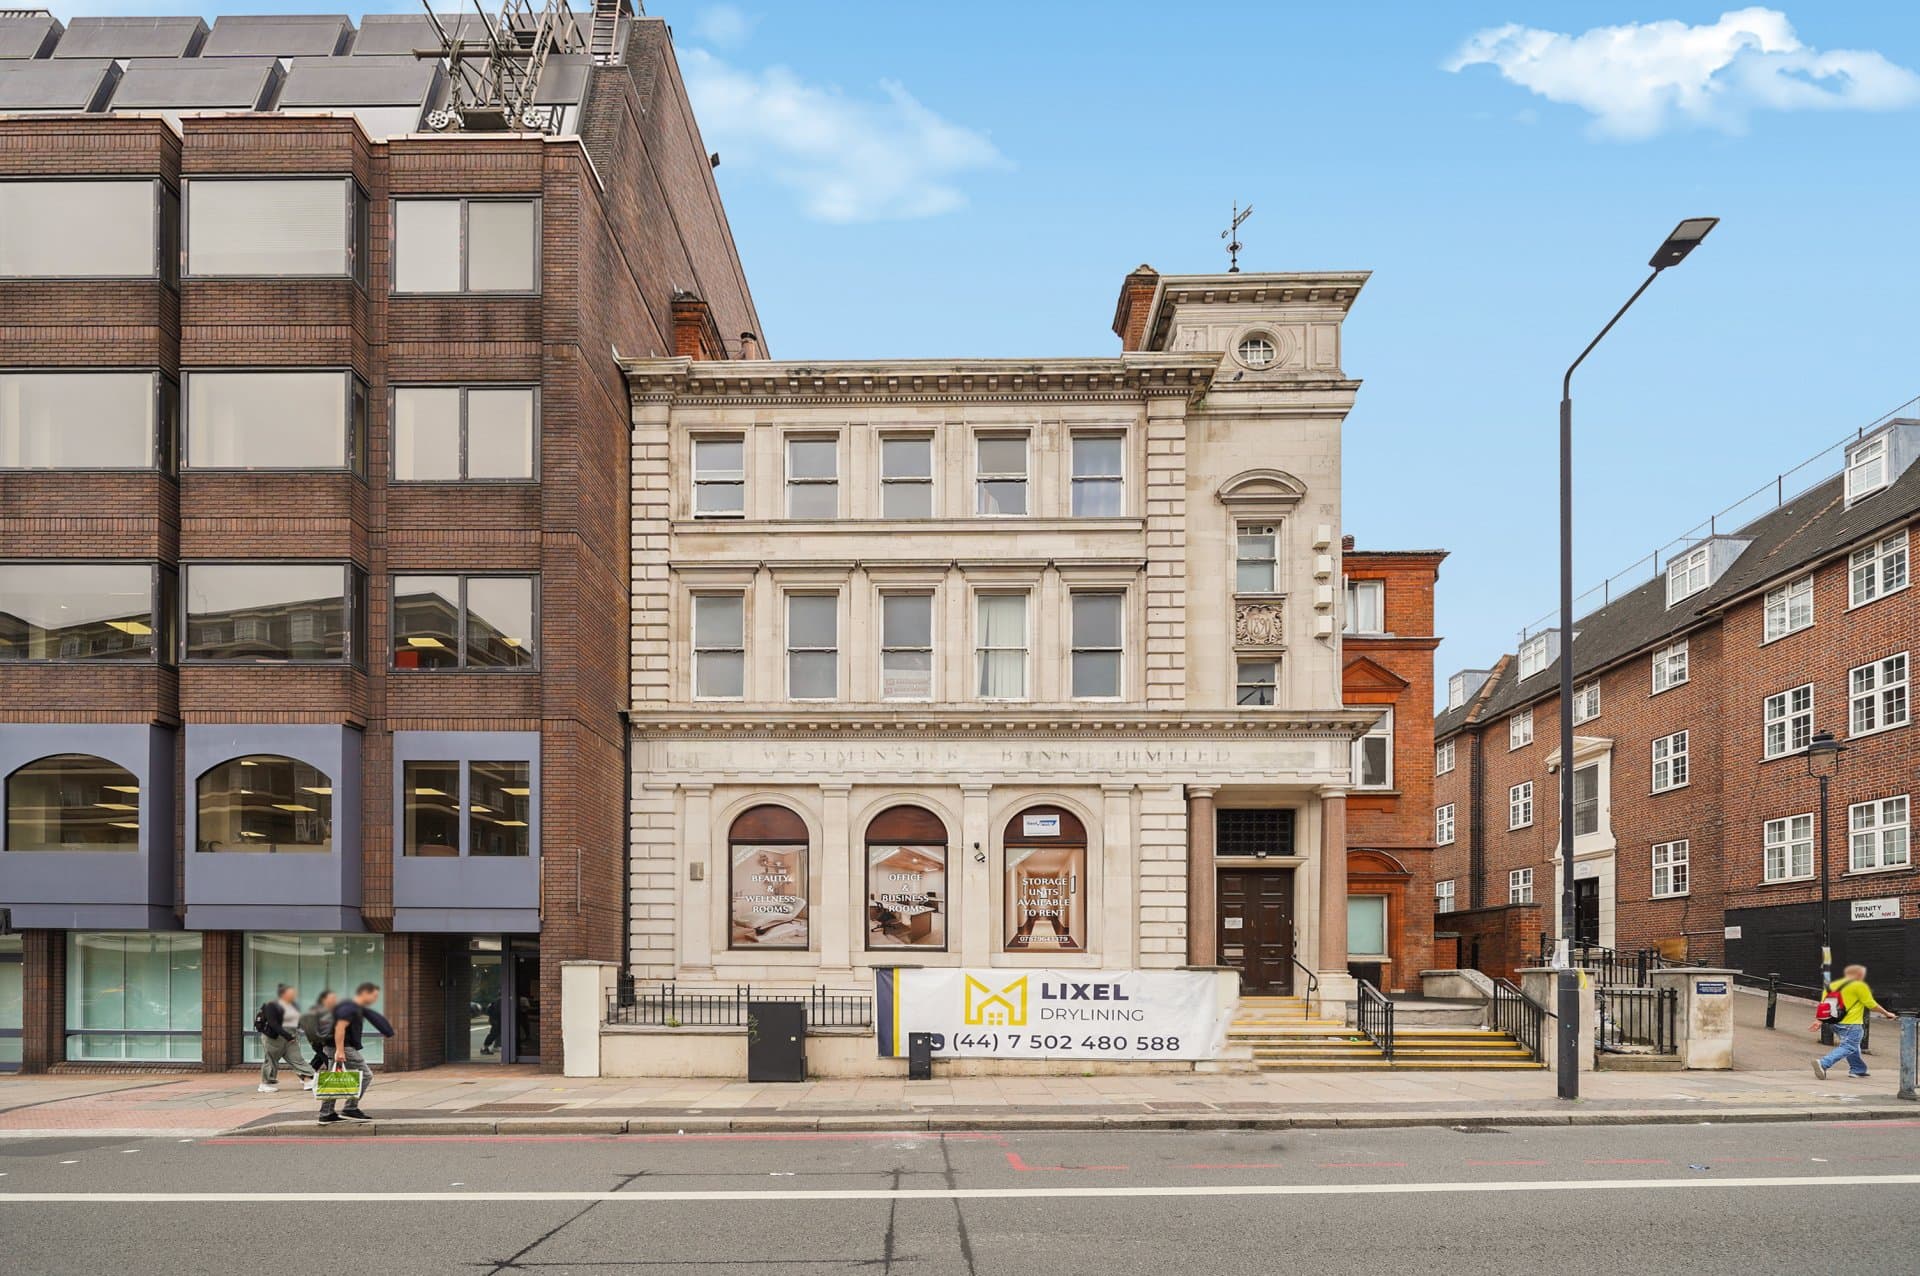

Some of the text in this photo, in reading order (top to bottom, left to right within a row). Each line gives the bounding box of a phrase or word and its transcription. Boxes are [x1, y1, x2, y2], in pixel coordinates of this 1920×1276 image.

[763, 750, 1232, 762] WESTMINSTER BANK LIMITED
[751, 874, 789, 882] BEAUTY
[889, 873, 923, 881] OFFICE
[1022, 877, 1068, 886] STORAGE
[767, 885, 774, 893] &
[1029, 888, 1059, 896] UNITS
[745, 895, 796, 903] WELLNESS
[882, 894, 929, 902] BUSINESS
[1017, 898, 1070, 906] AVAILABLE
[752, 905, 789, 913] ROOMS
[1855, 904, 1882, 912] TRINITY
[1024, 909, 1065, 917] TO RENT
[1041, 982, 1130, 1001] LIXEL
[1040, 1007, 1144, 1022] DRYLINING
[952, 1031, 1180, 1052] (44) 7 502 480 588
